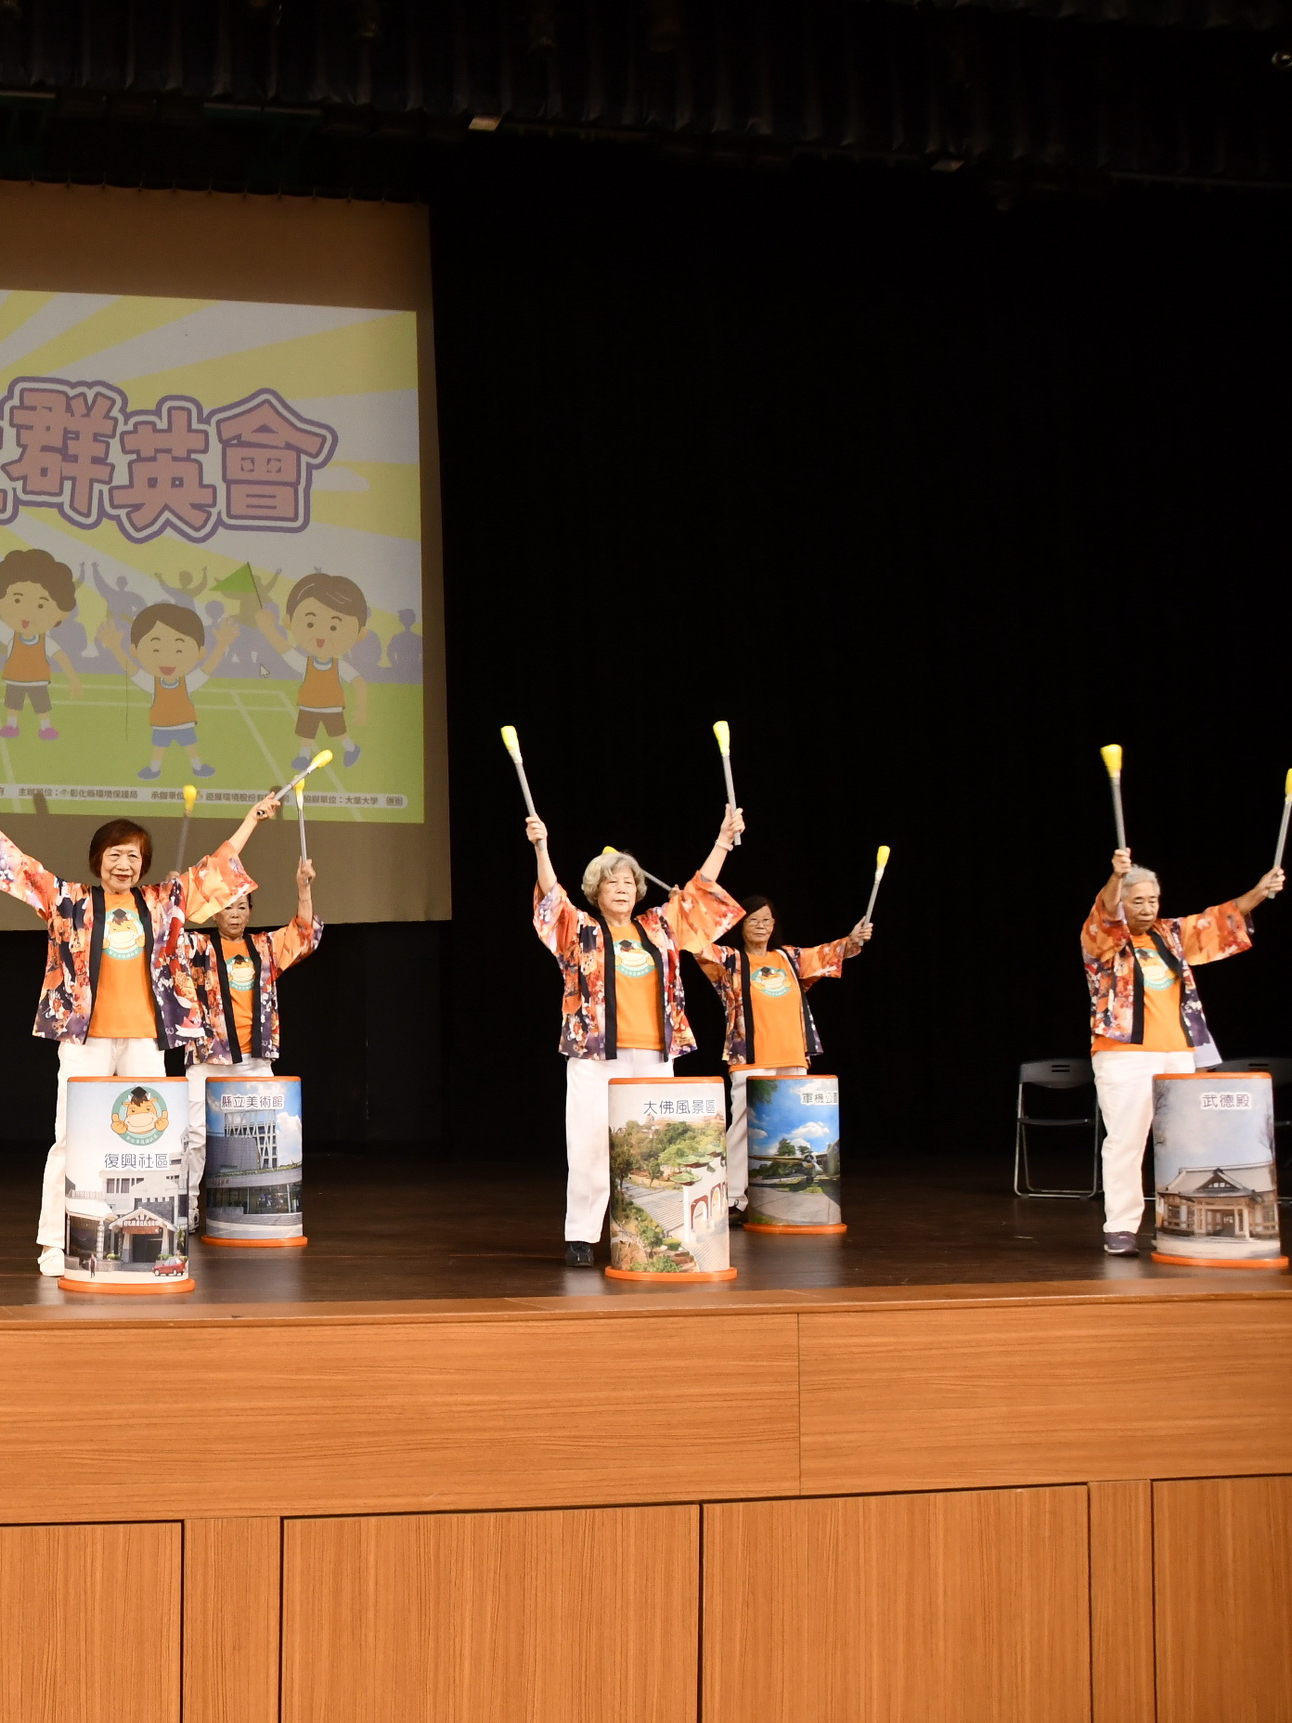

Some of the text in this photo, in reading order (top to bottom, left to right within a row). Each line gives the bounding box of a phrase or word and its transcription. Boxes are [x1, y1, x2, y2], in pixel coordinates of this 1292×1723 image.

[221, 1095, 284, 1109] 縣立美術館
[643, 1099, 716, 1115] 大佛風景區
[1202, 1093, 1251, 1109] 武德殿
[104, 1153, 169, 1169] 復興社區
